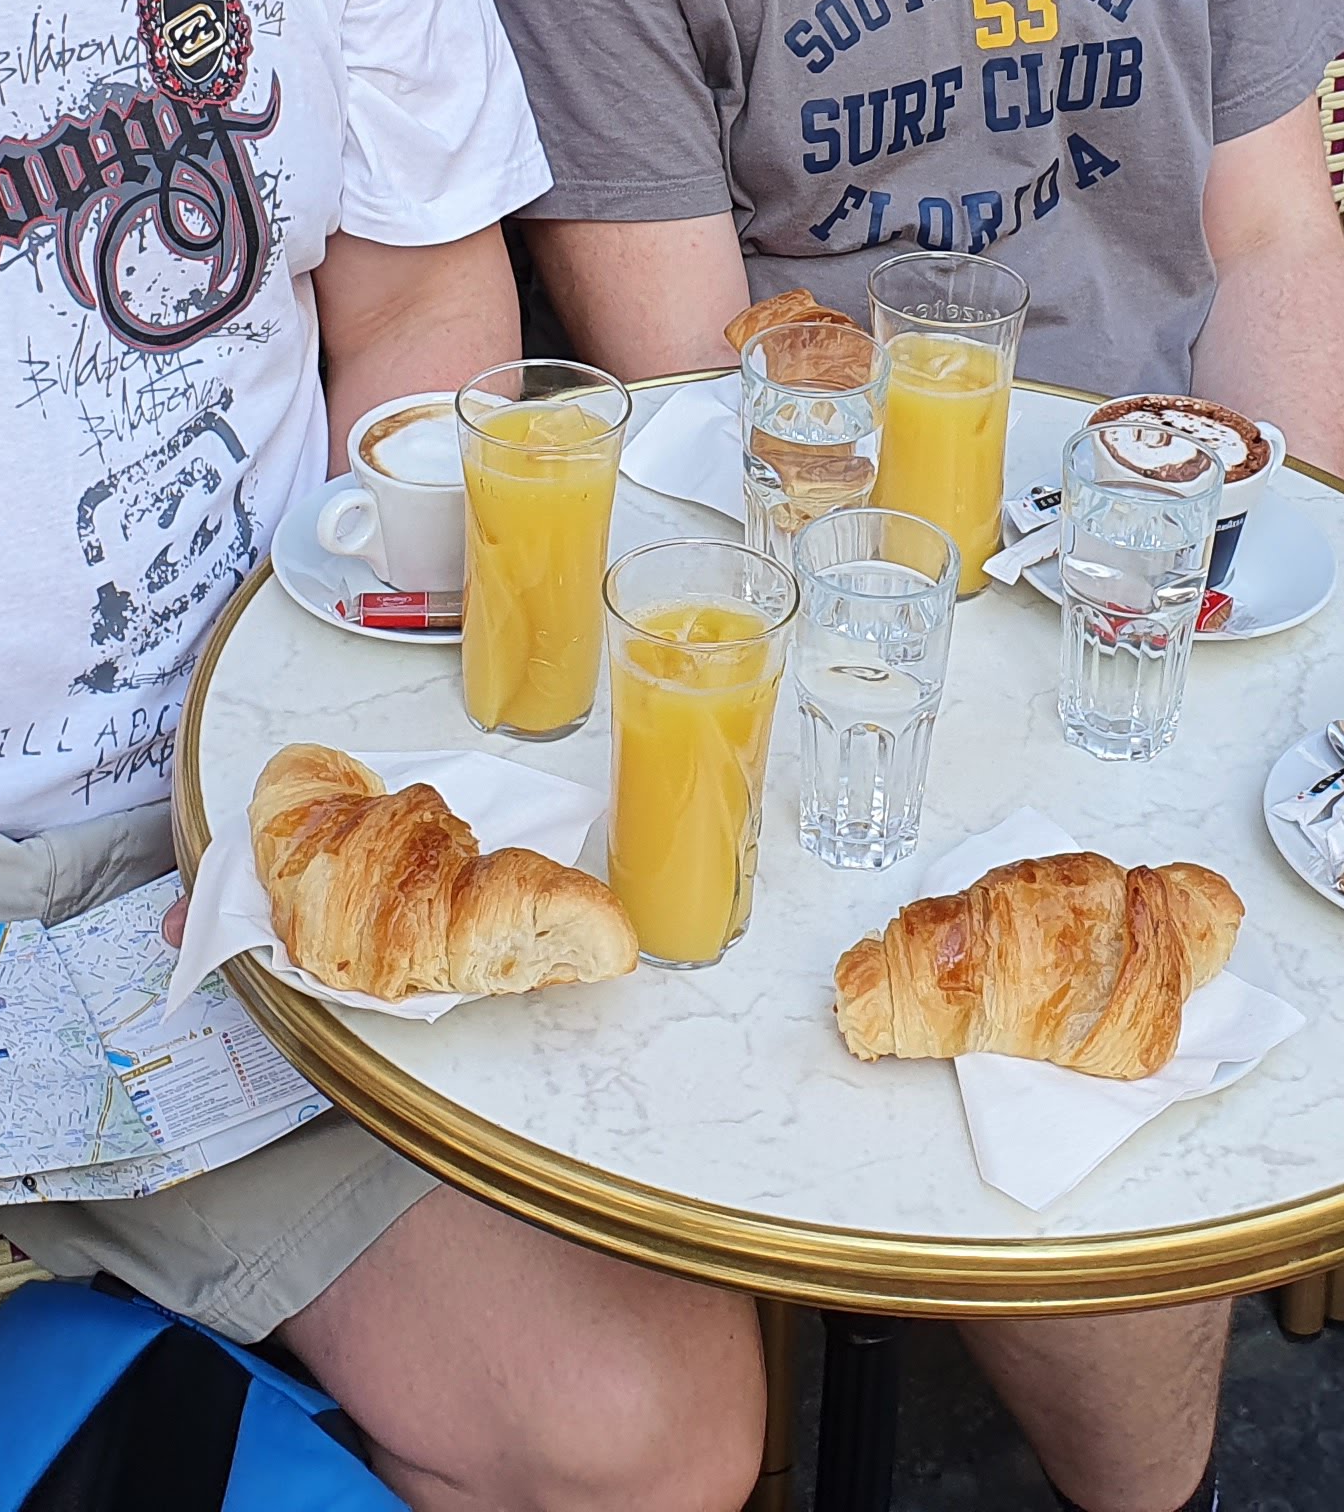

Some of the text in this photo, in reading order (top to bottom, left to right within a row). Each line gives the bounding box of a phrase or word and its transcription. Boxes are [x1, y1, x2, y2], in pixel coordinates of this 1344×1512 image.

[800, 36, 1144, 175] SURF CLUB
[809, 131, 1121, 255] FLORIDA
